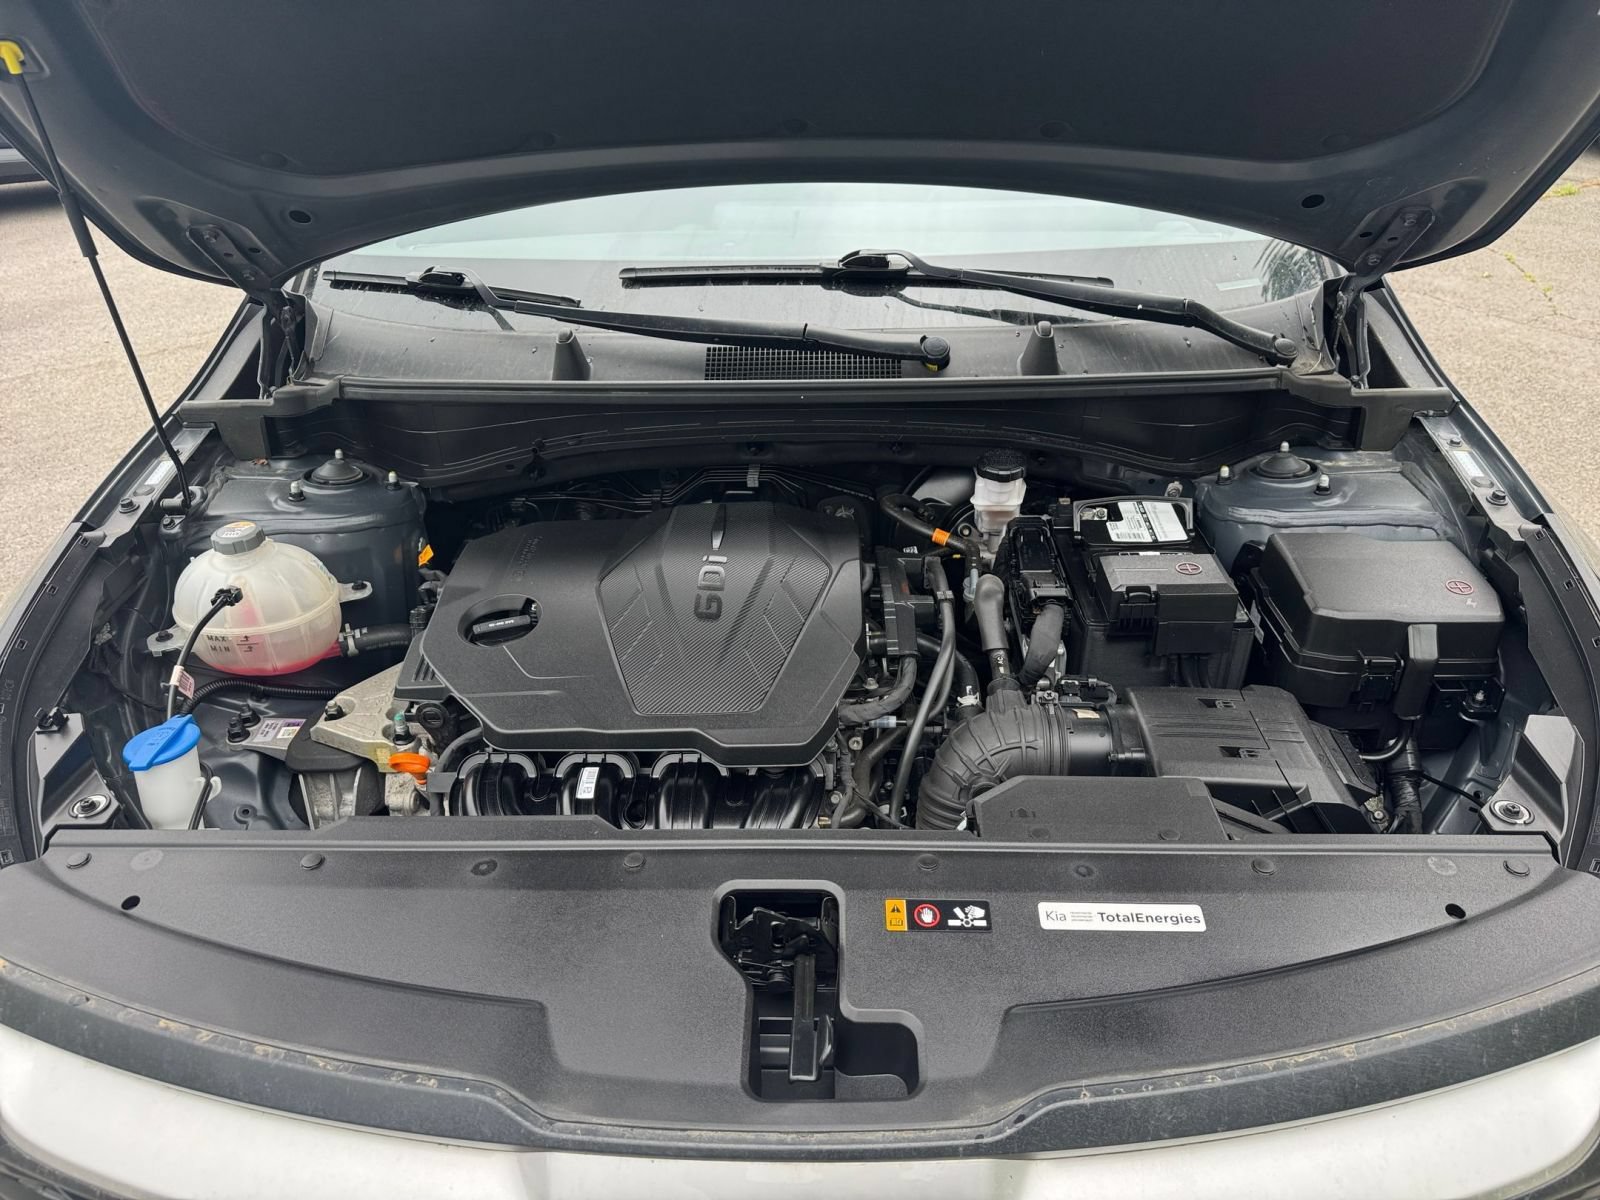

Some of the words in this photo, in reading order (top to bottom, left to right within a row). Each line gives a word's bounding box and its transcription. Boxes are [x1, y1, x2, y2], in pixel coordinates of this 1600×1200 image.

[694, 555, 727, 620] GDi
[206, 634, 227, 642] MAX
[1045, 910, 1067, 922] Kia
[1097, 911, 1201, 926] TotalEnergies
